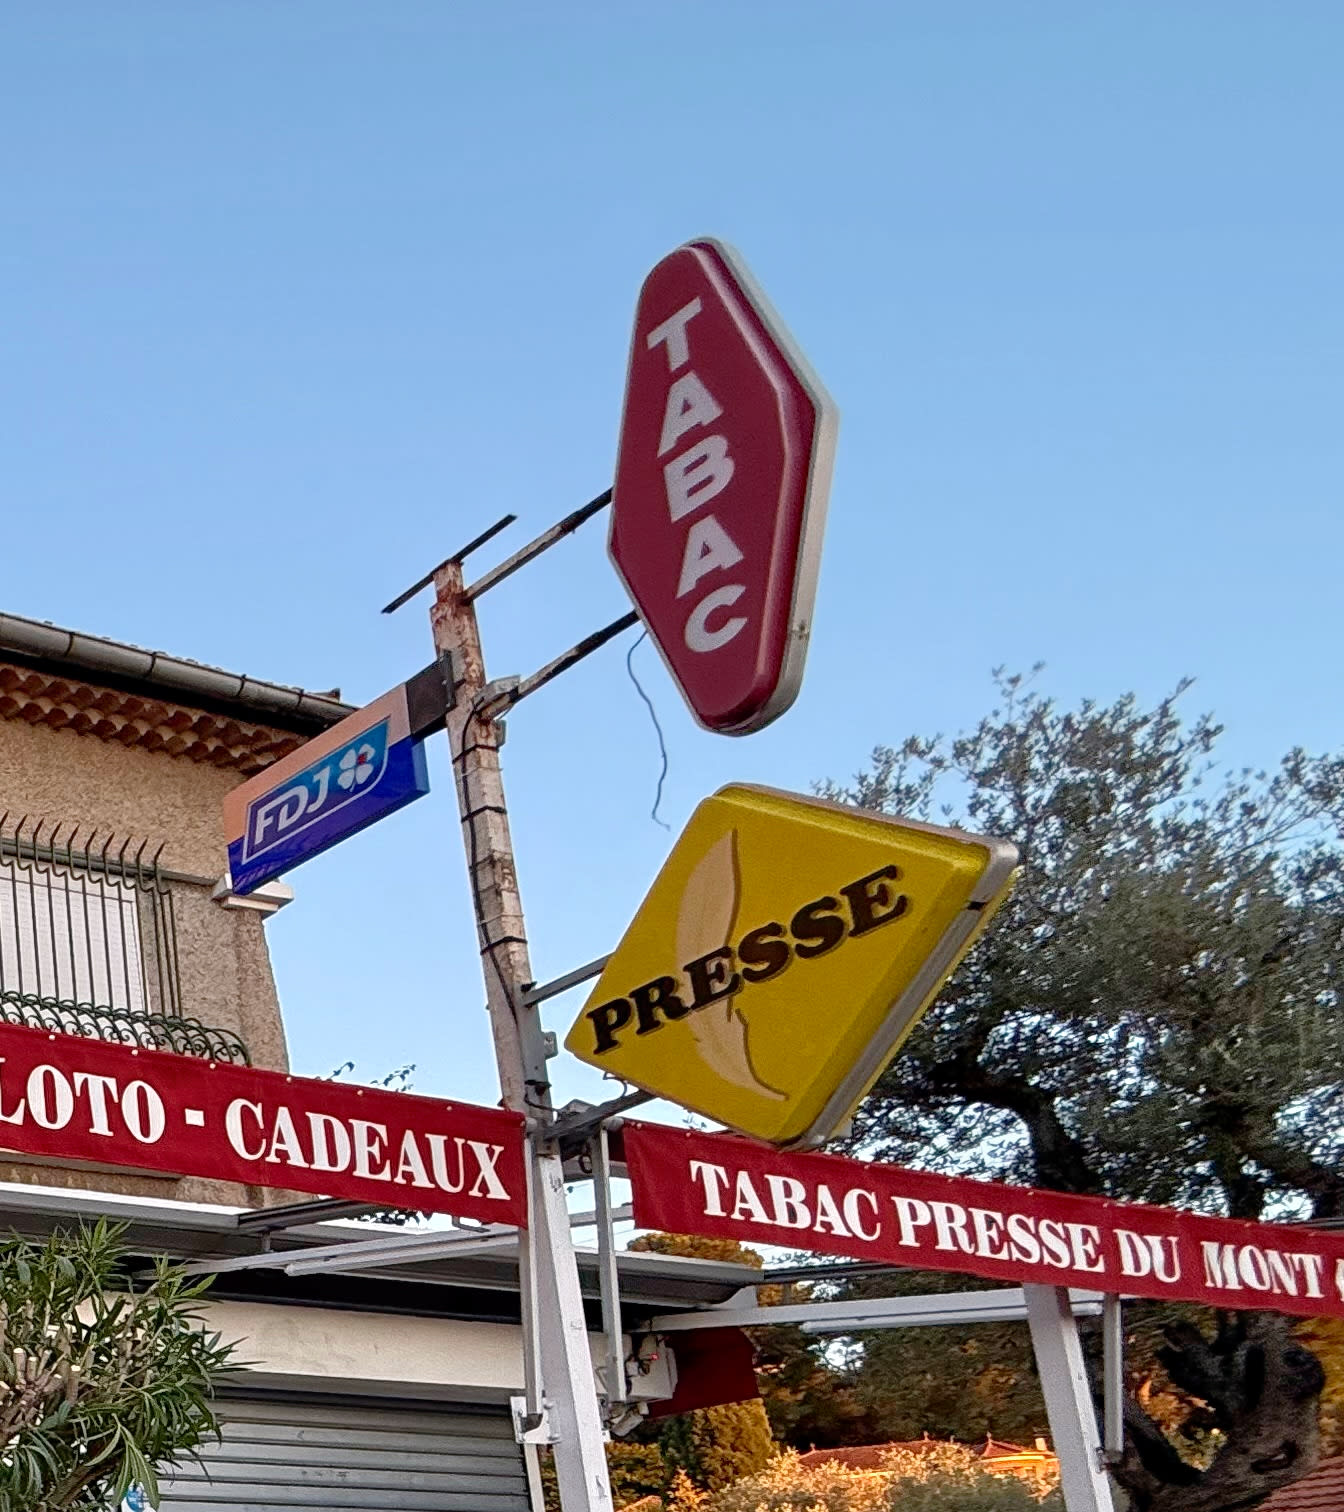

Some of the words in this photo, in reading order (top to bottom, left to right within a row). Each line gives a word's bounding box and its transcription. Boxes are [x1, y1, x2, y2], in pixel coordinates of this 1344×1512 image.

[646, 297, 748, 653] TABAC
[254, 766, 332, 846] FDJ
[586, 863, 911, 1056] PRESSE
[225, 1098, 512, 1201] CADEAUX
[689, 1160, 881, 1242] TABAC
[891, 1196, 1106, 1275] PRESSE
[1113, 1228, 1181, 1284] DU
[1201, 1241, 1325, 1299] MONT
